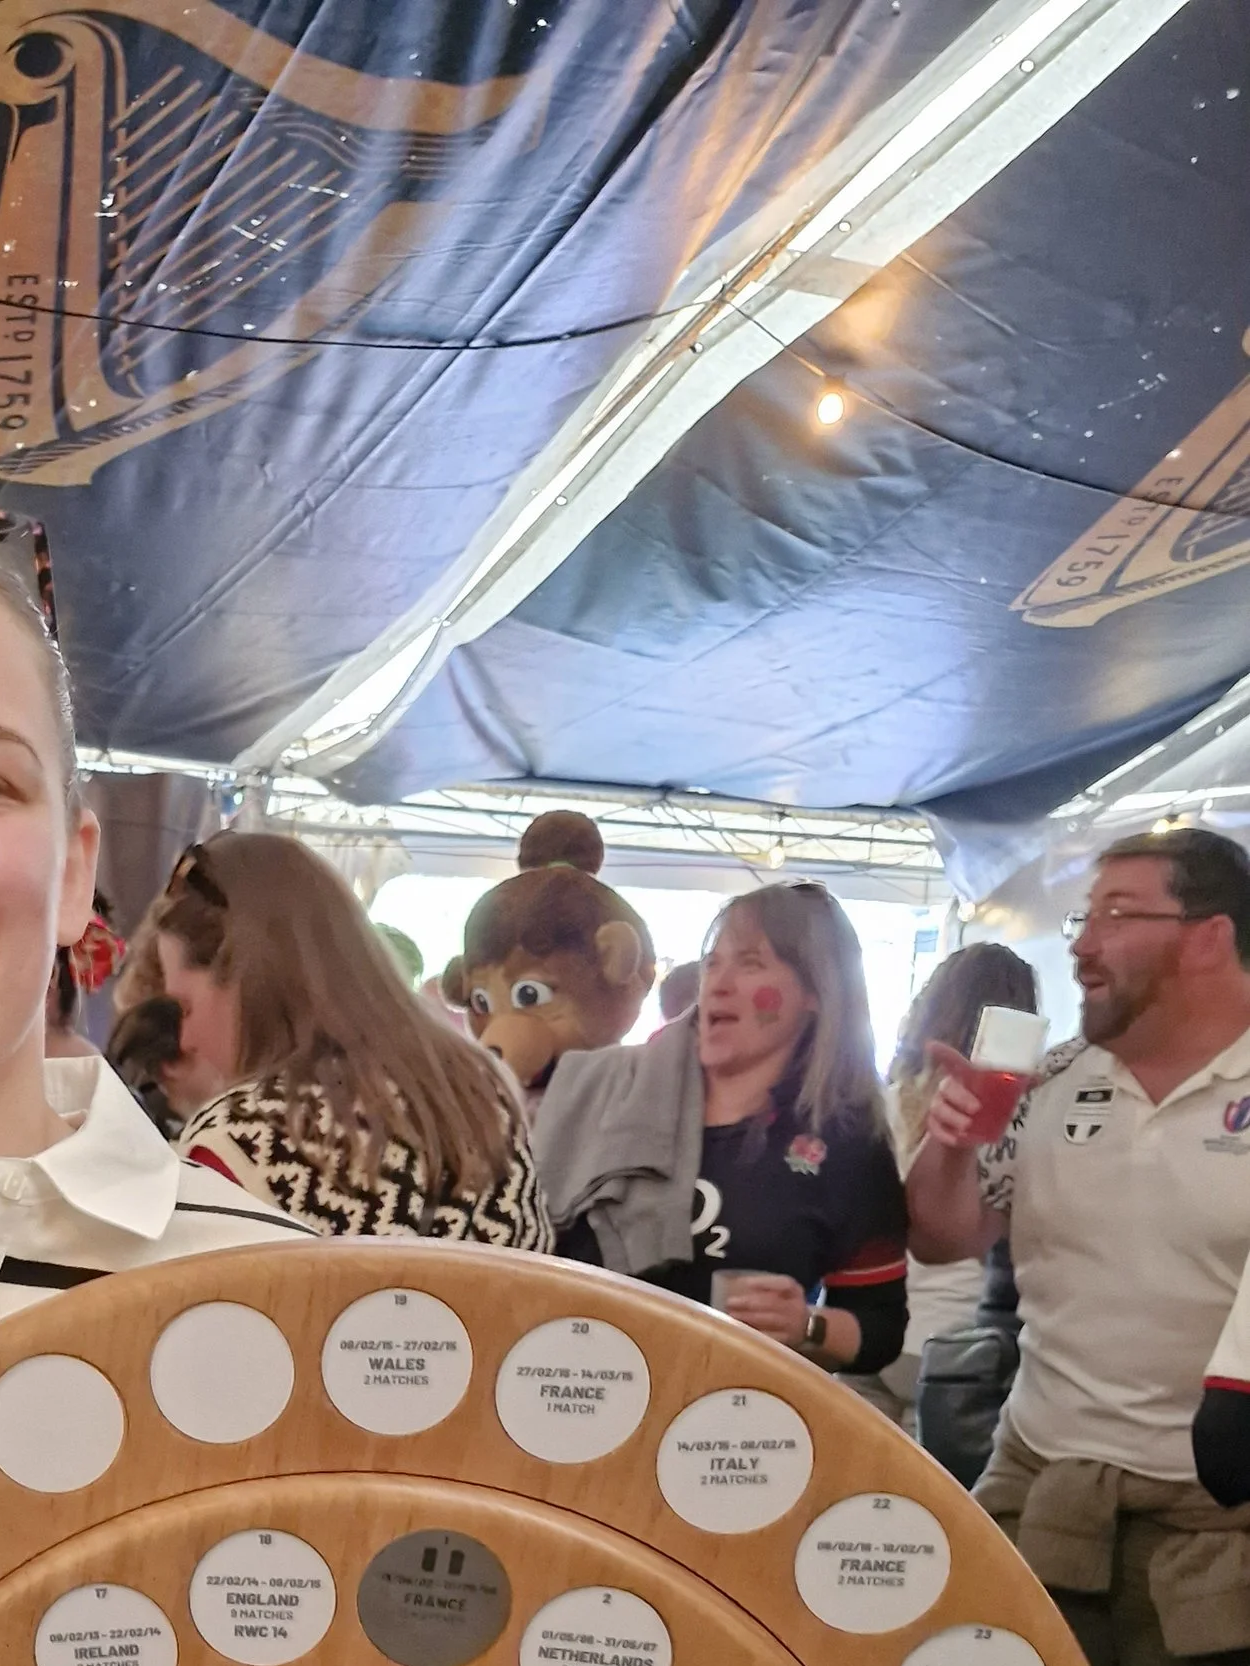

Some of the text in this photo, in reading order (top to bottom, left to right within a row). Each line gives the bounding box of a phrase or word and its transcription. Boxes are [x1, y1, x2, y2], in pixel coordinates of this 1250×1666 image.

[1056, 533, 1130, 588] 1759
[395, 1295, 406, 1305] 19
[571, 1323, 589, 1334] 20
[369, 1358, 425, 1370] WALES
[364, 1375, 429, 1385] 2 MATCHES
[540, 1385, 605, 1400] FRANCE
[732, 1396, 746, 1406] 21
[553, 1404, 595, 1414] MATCH
[710, 1458, 760, 1470] ITALY
[701, 1475, 767, 1485] 2 MATCHES
[873, 1498, 890, 1510] 22
[259, 1534, 271, 1544] 18
[840, 1559, 906, 1573] FRANCE
[838, 1575, 904, 1587] 2 MATCHES
[95, 1588, 107, 1598] 17
[603, 1594, 611, 1603] 2
[226, 1593, 299, 1606] ENGLAND
[240, 1610, 293, 1620] MATCHES
[234, 1625, 287, 1638] RWC 14
[974, 1629, 992, 1640] 23
[74, 1644, 139, 1659] IRELAND
